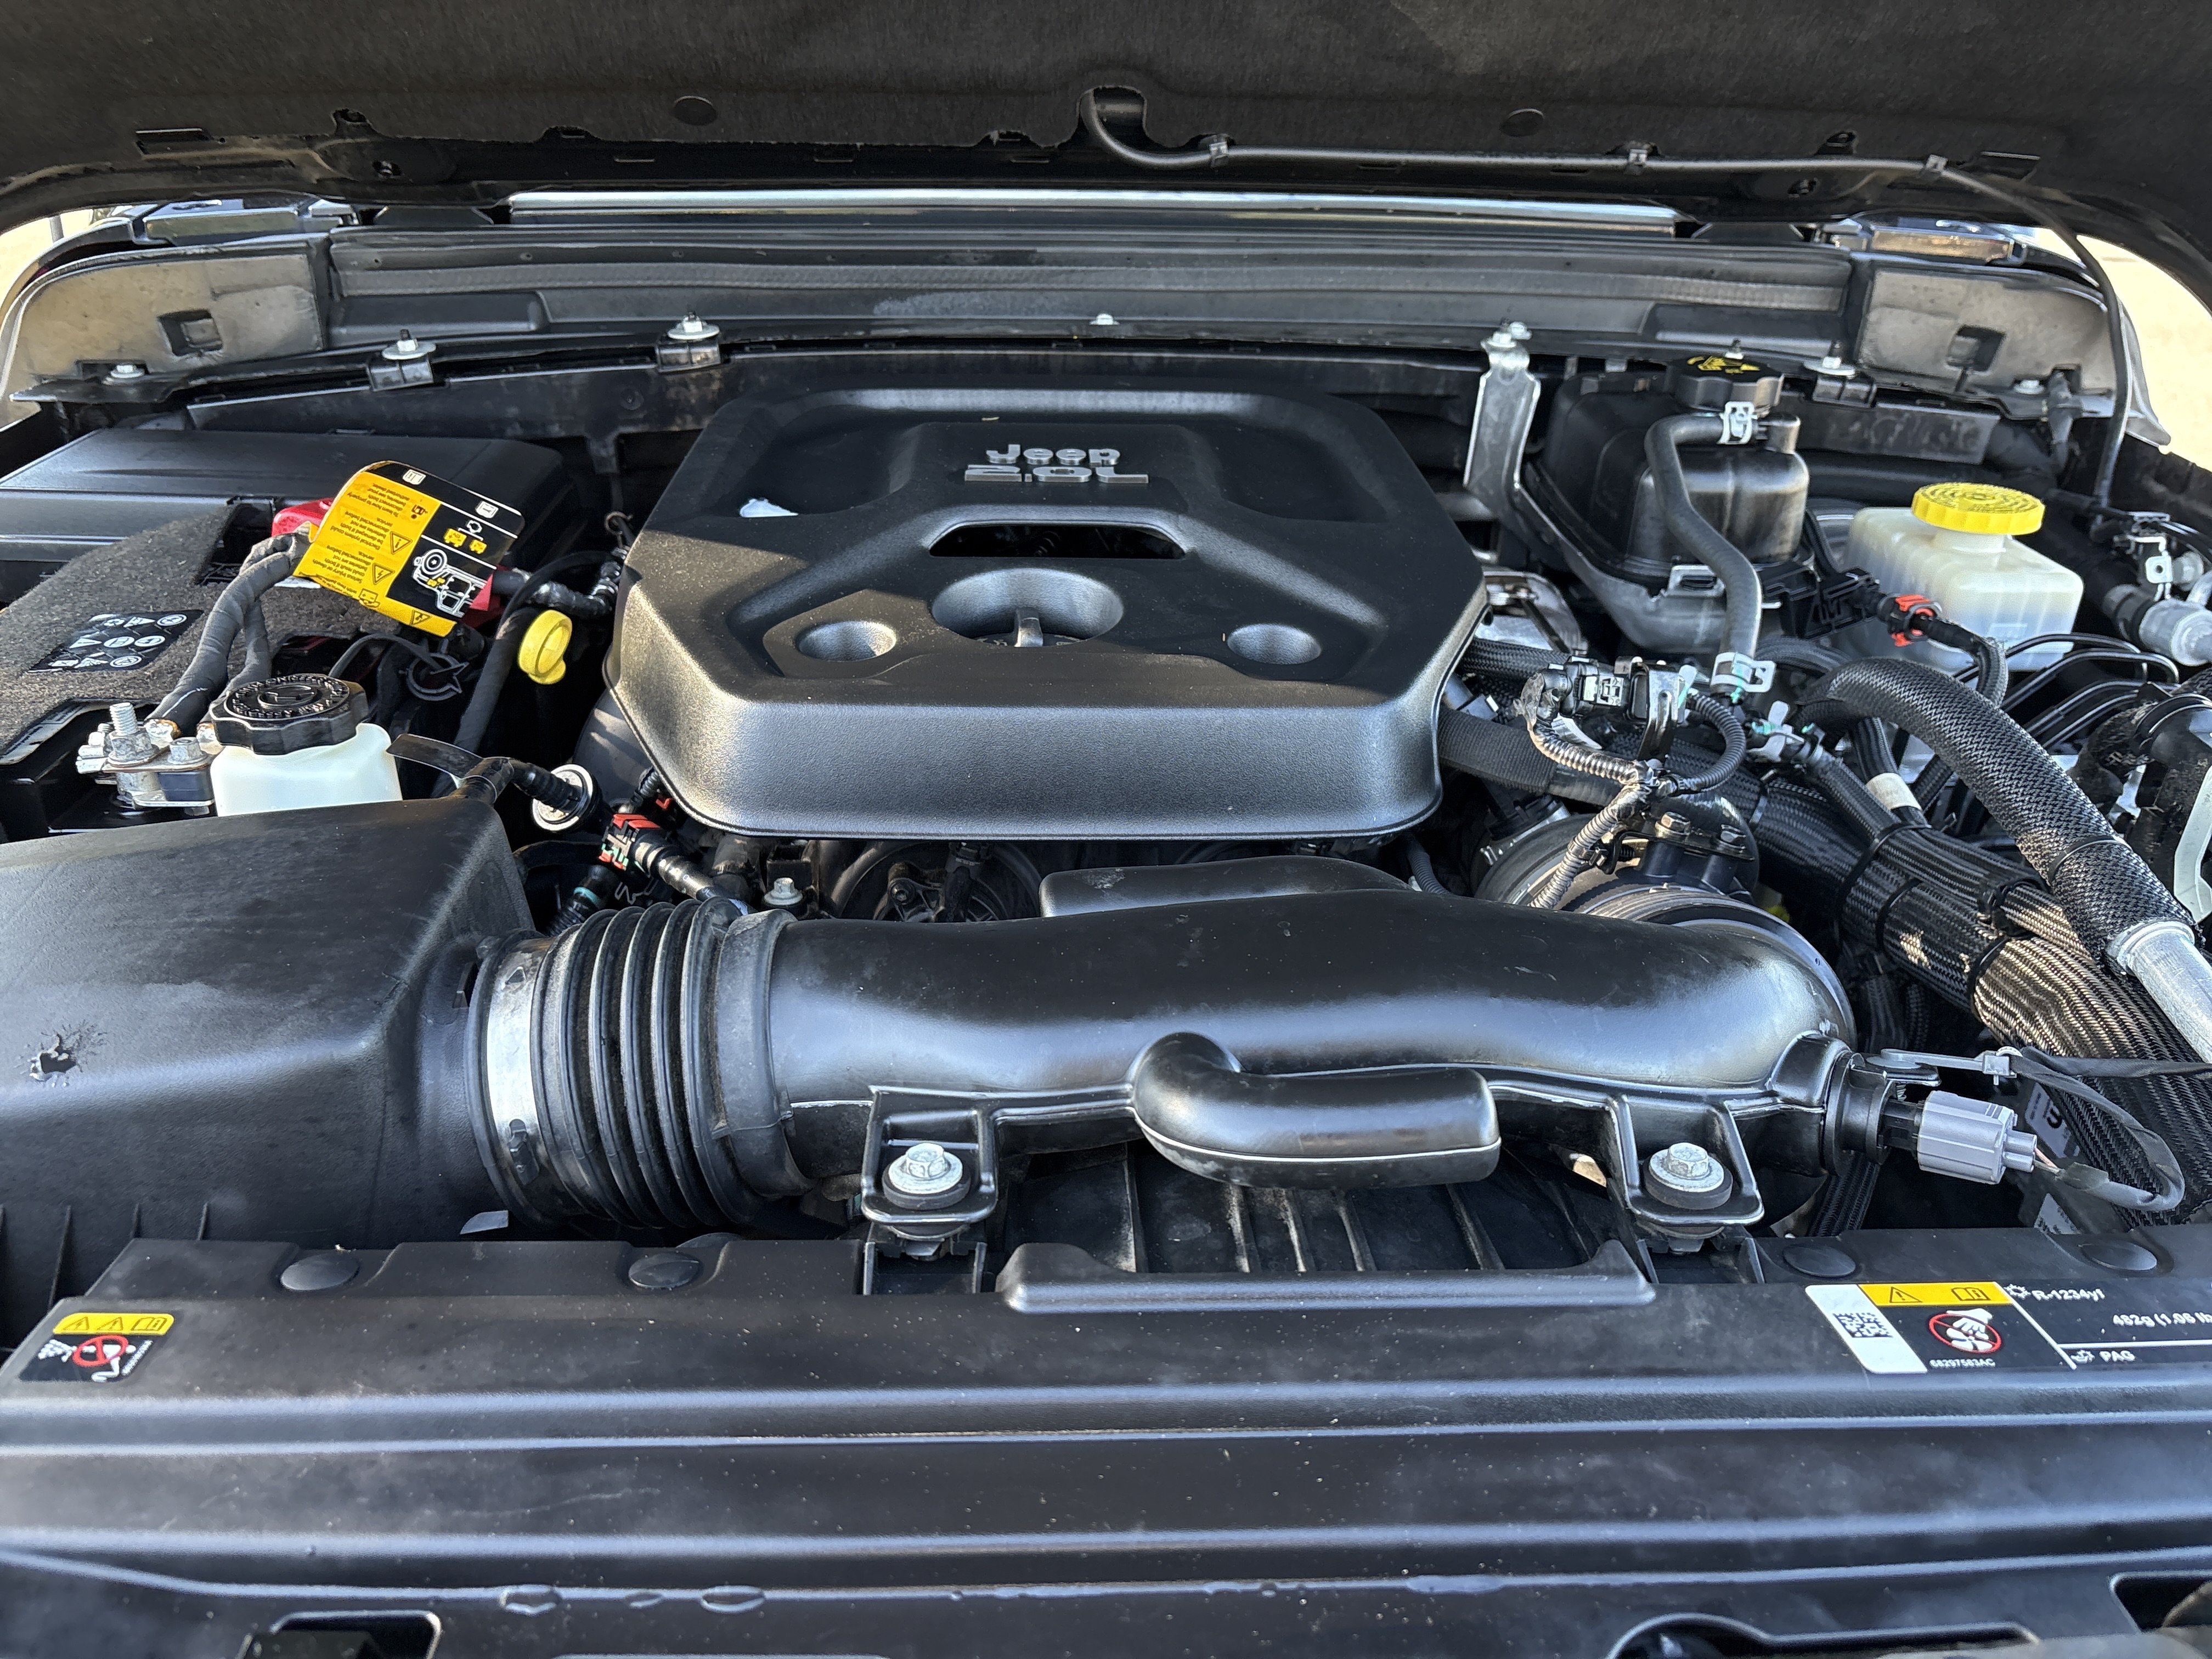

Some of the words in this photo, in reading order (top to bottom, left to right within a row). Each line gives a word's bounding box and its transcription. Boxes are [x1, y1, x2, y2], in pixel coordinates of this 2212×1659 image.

[986, 444, 1120, 467] Jeep
[964, 465, 1149, 483] 2.0L
[347, 492, 366, 502] properly
[386, 489, 409, 500] authorized
[379, 499, 402, 511] disconnect
[345, 511, 360, 520] before
[330, 526, 344, 534] could
[340, 522, 352, 531] both
[359, 517, 389, 532] disconnected
[344, 532, 360, 540] system
[355, 529, 376, 540] damaged
[366, 527, 386, 539] batteries
[326, 545, 341, 554] before
[360, 539, 380, 550] Electrical
[312, 559, 326, 568] death
[341, 552, 370, 565] disconnected
[348, 561, 367, 571] batteries
[332, 568, 346, 577] injury
[347, 574, 362, 583] Serious
[2032, 1289, 2105, 1302] R-1234yf
[2113, 1314, 2155, 1328] 482g
[2099, 1350, 2135, 1362] PAG
